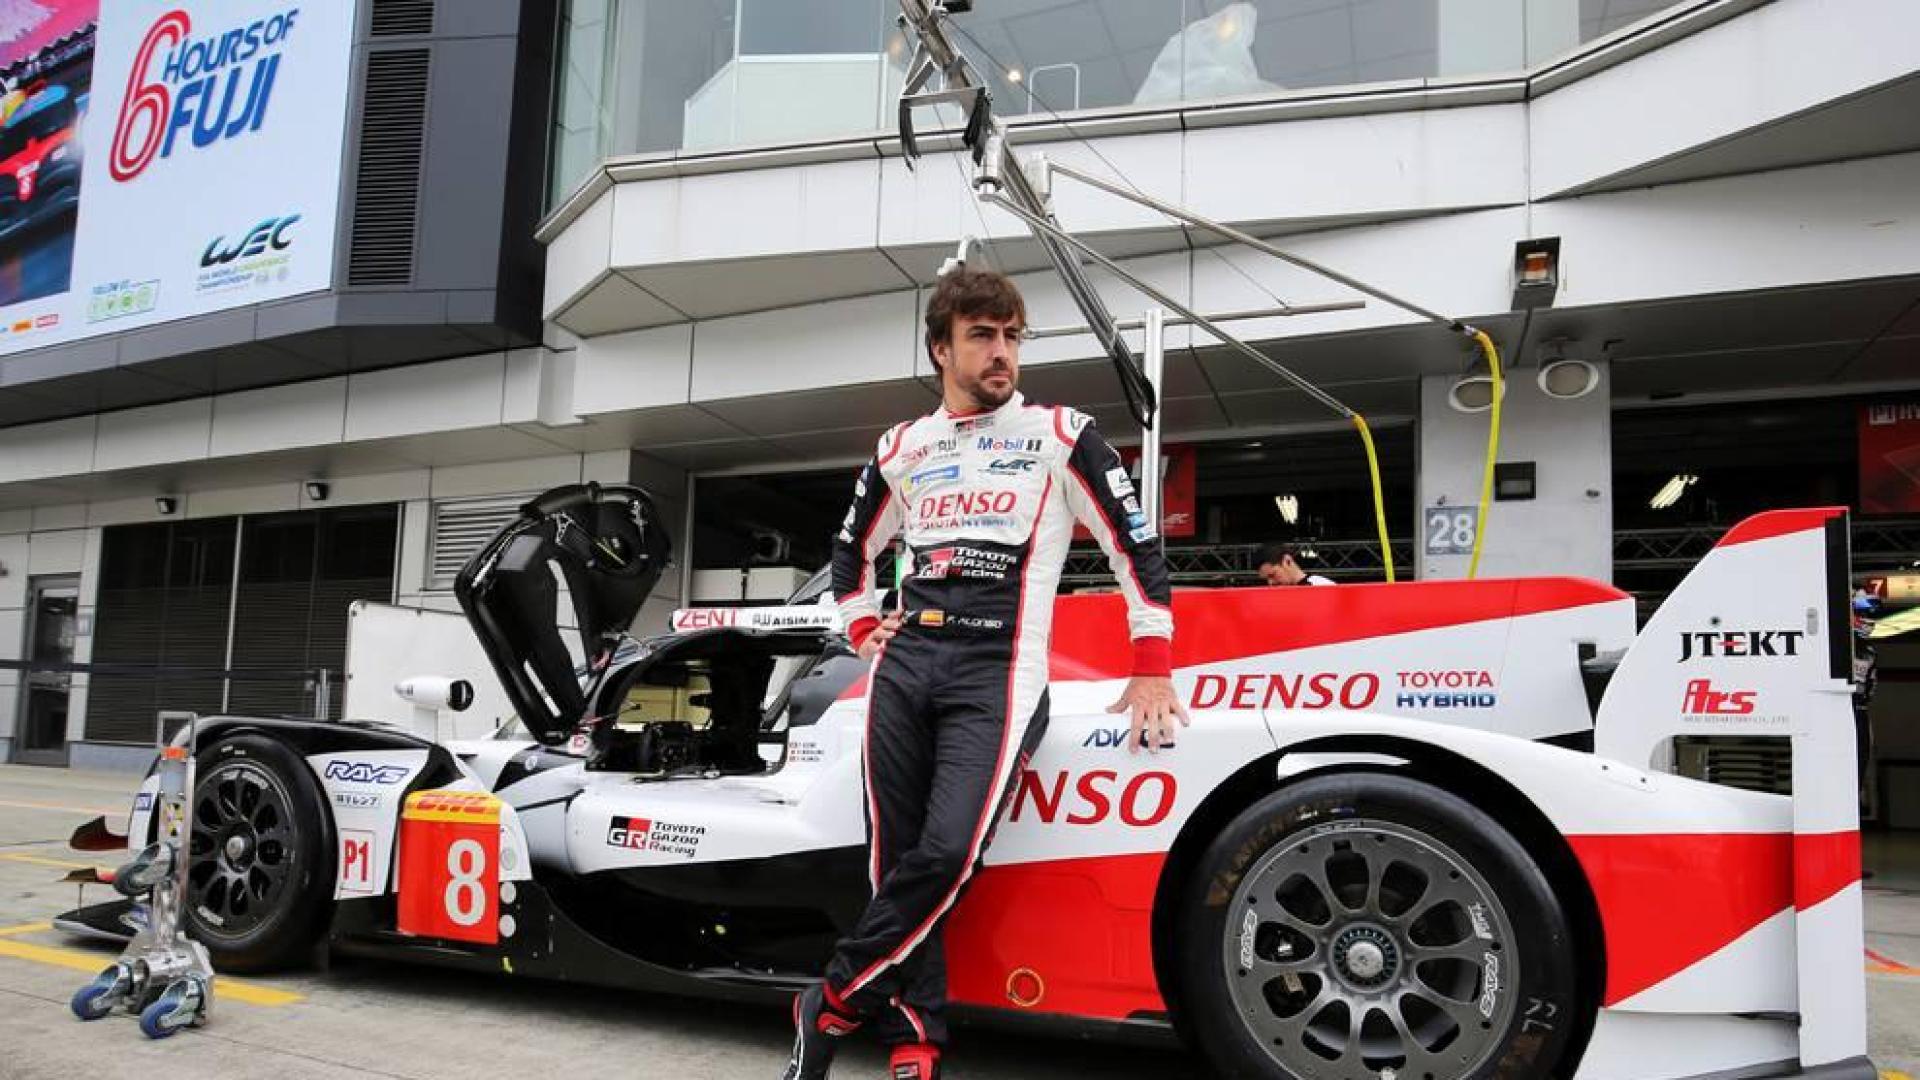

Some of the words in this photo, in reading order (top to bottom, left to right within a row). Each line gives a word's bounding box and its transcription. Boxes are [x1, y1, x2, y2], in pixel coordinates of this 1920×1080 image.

[163, 27, 257, 84] HOURS
[265, 9, 299, 46] OF
[109, 9, 191, 182] 6
[160, 53, 281, 158] FUJI
[200, 213, 301, 267] WEC
[977, 435, 1024, 451] Mobil
[920, 490, 1017, 519] DENSO
[1428, 513, 1475, 548] 28
[677, 608, 736, 629] ZENT
[772, 615, 808, 625] AISIN
[1677, 631, 1804, 663] JTEKT
[1190, 672, 1380, 710] DENSO
[1397, 670, 1494, 687] TOYOTA
[1397, 693, 1496, 708] HYBRID
[326, 760, 409, 784] RAYS
[1008, 769, 1178, 827] NSO
[608, 828, 649, 850] GR
[651, 832, 699, 846] GAZOO
[653, 821, 706, 836] TOYOTA
[343, 838, 369, 884] P1
[650, 841, 696, 857] Racing
[444, 838, 486, 926] 8
